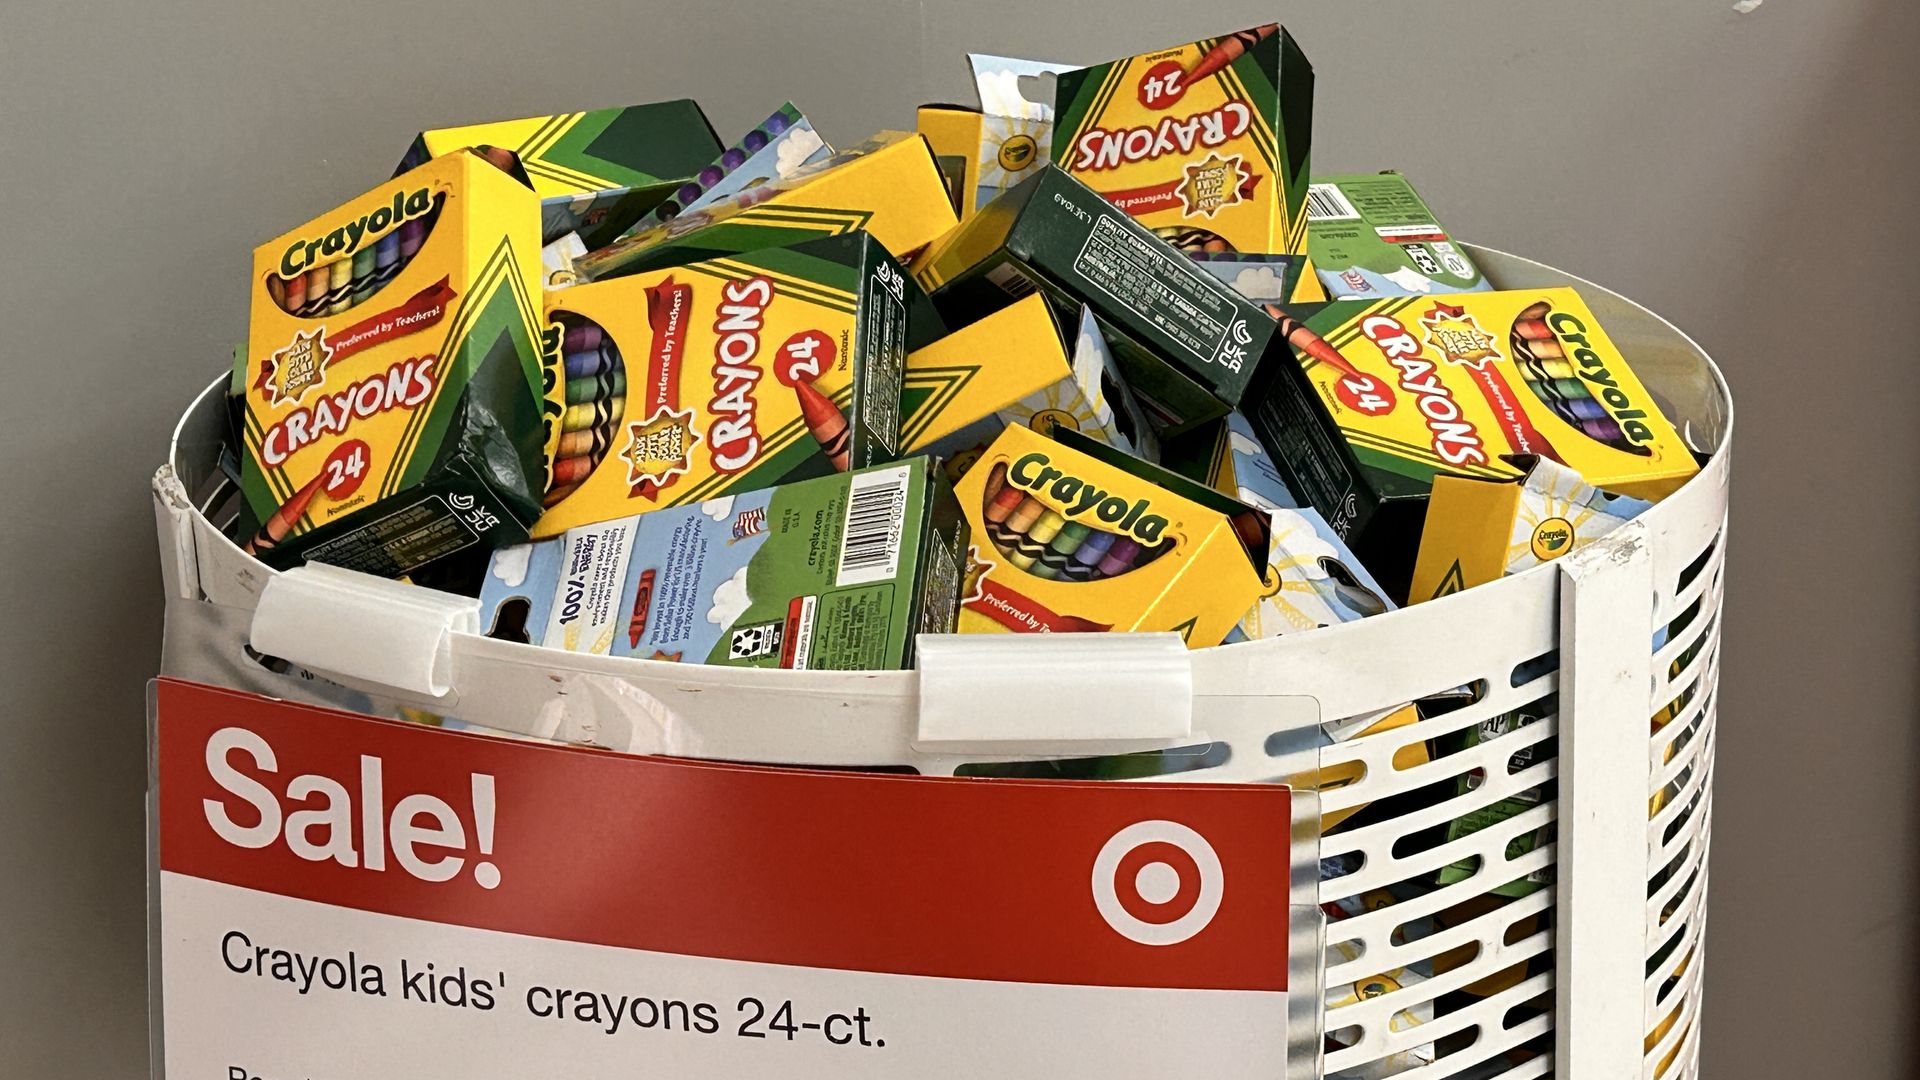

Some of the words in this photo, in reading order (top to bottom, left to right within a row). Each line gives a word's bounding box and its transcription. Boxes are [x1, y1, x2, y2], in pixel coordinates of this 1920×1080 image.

[1144, 70, 1183, 103] 24
[1078, 102, 1250, 169] CRAYONS
[1126, 191, 1172, 207] Preferred
[281, 188, 429, 276] Crayola
[336, 326, 379, 351] Preferred
[382, 322, 393, 333] by
[396, 306, 440, 326] Teachers!
[665, 290, 682, 337] Teachers!
[662, 340, 676, 354] by
[787, 337, 820, 380] 24
[1218, 351, 1241, 374] CA
[1224, 340, 1247, 364] UK
[657, 355, 671, 404] Preferred
[713, 280, 770, 470] CRAYONS
[1343, 377, 1389, 411] 24
[1362, 316, 1485, 464] CRAYONS
[1550, 313, 1654, 441] Crayola
[264, 359, 433, 465] CRAYONS
[327, 447, 365, 490] 24
[464, 505, 491, 523] UK
[1011, 453, 1168, 542] Crayola
[475, 515, 500, 532] CA
[807, 509, 824, 565] crayola.com
[559, 575, 583, 624] 100%
[983, 593, 1030, 621] Preferred
[1026, 615, 1040, 629] by
[203, 726, 501, 889] Sale!
[221, 931, 386, 994] Crayola
[401, 959, 505, 1010] kids'
[526, 985, 719, 1035] crayons
[737, 997, 886, 1048] 24-ct.
